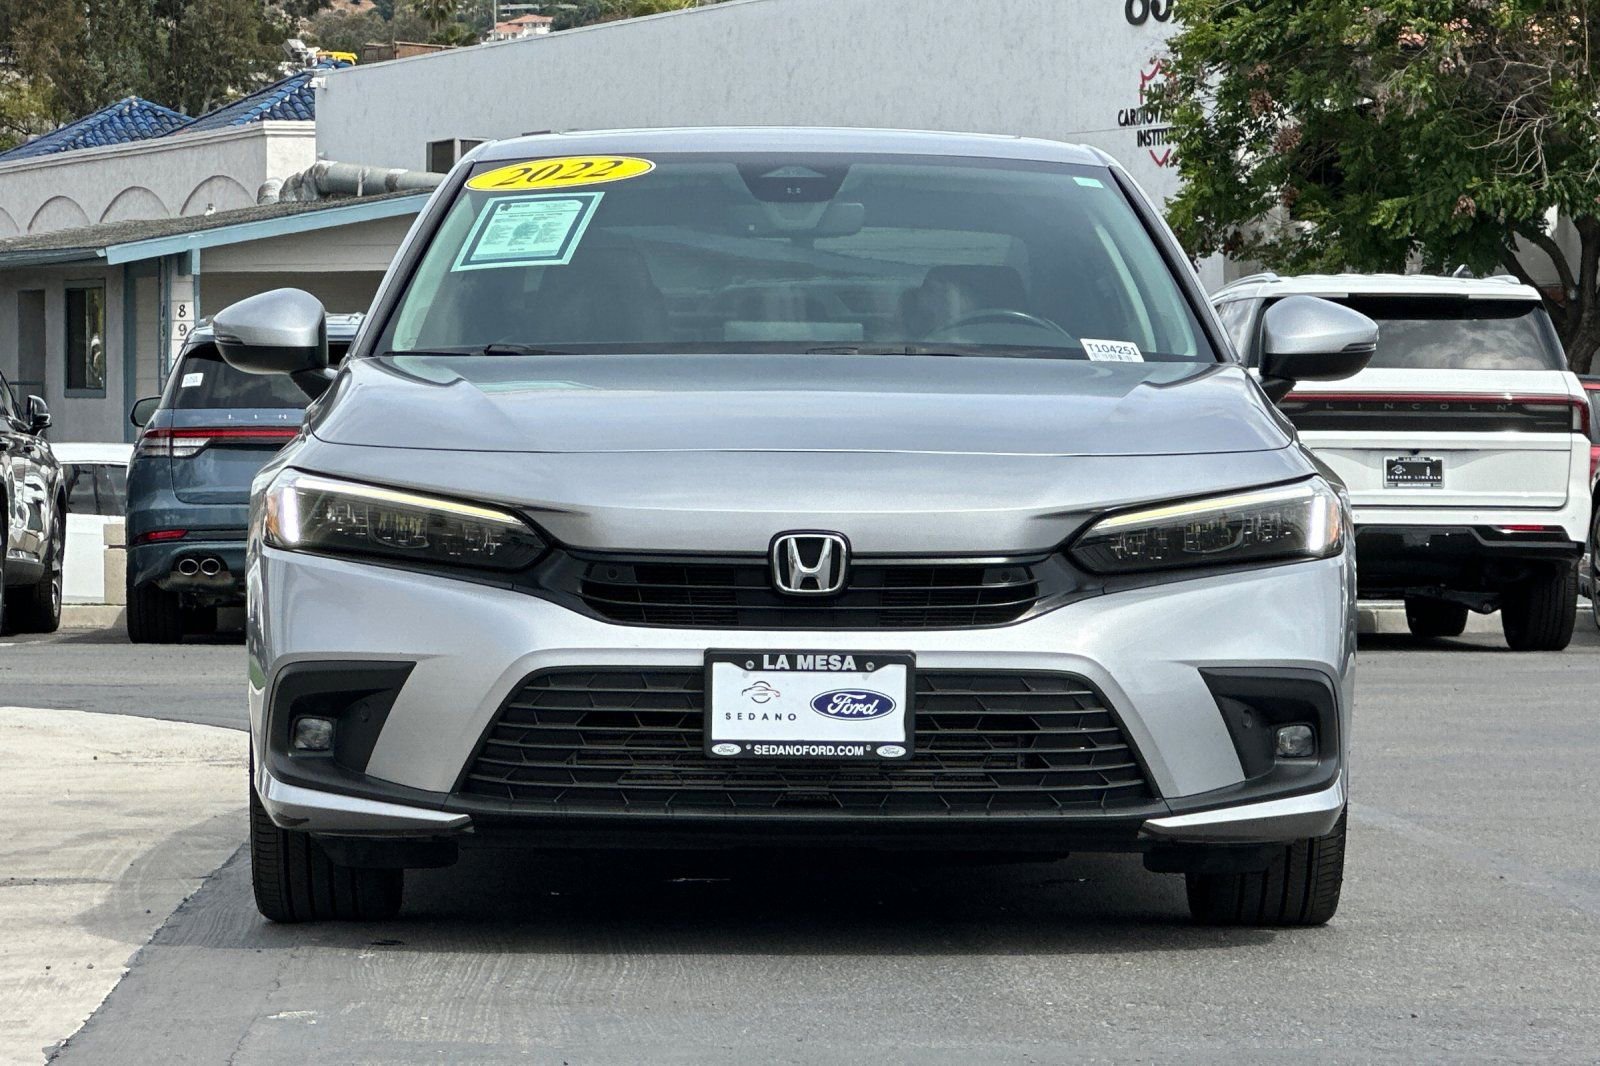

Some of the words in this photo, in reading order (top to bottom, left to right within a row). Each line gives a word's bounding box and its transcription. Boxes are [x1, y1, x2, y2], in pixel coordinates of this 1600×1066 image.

[492, 160, 624, 187] 2022
[1086, 343, 1139, 356] T104251
[1326, 402, 1507, 411] LINCOLN
[763, 654, 790, 670] LA
[796, 655, 857, 671] MESA
[827, 692, 878, 715] Ford
[725, 712, 797, 721] SEDANO
[753, 744, 864, 756] SEDANOFORD.COM
